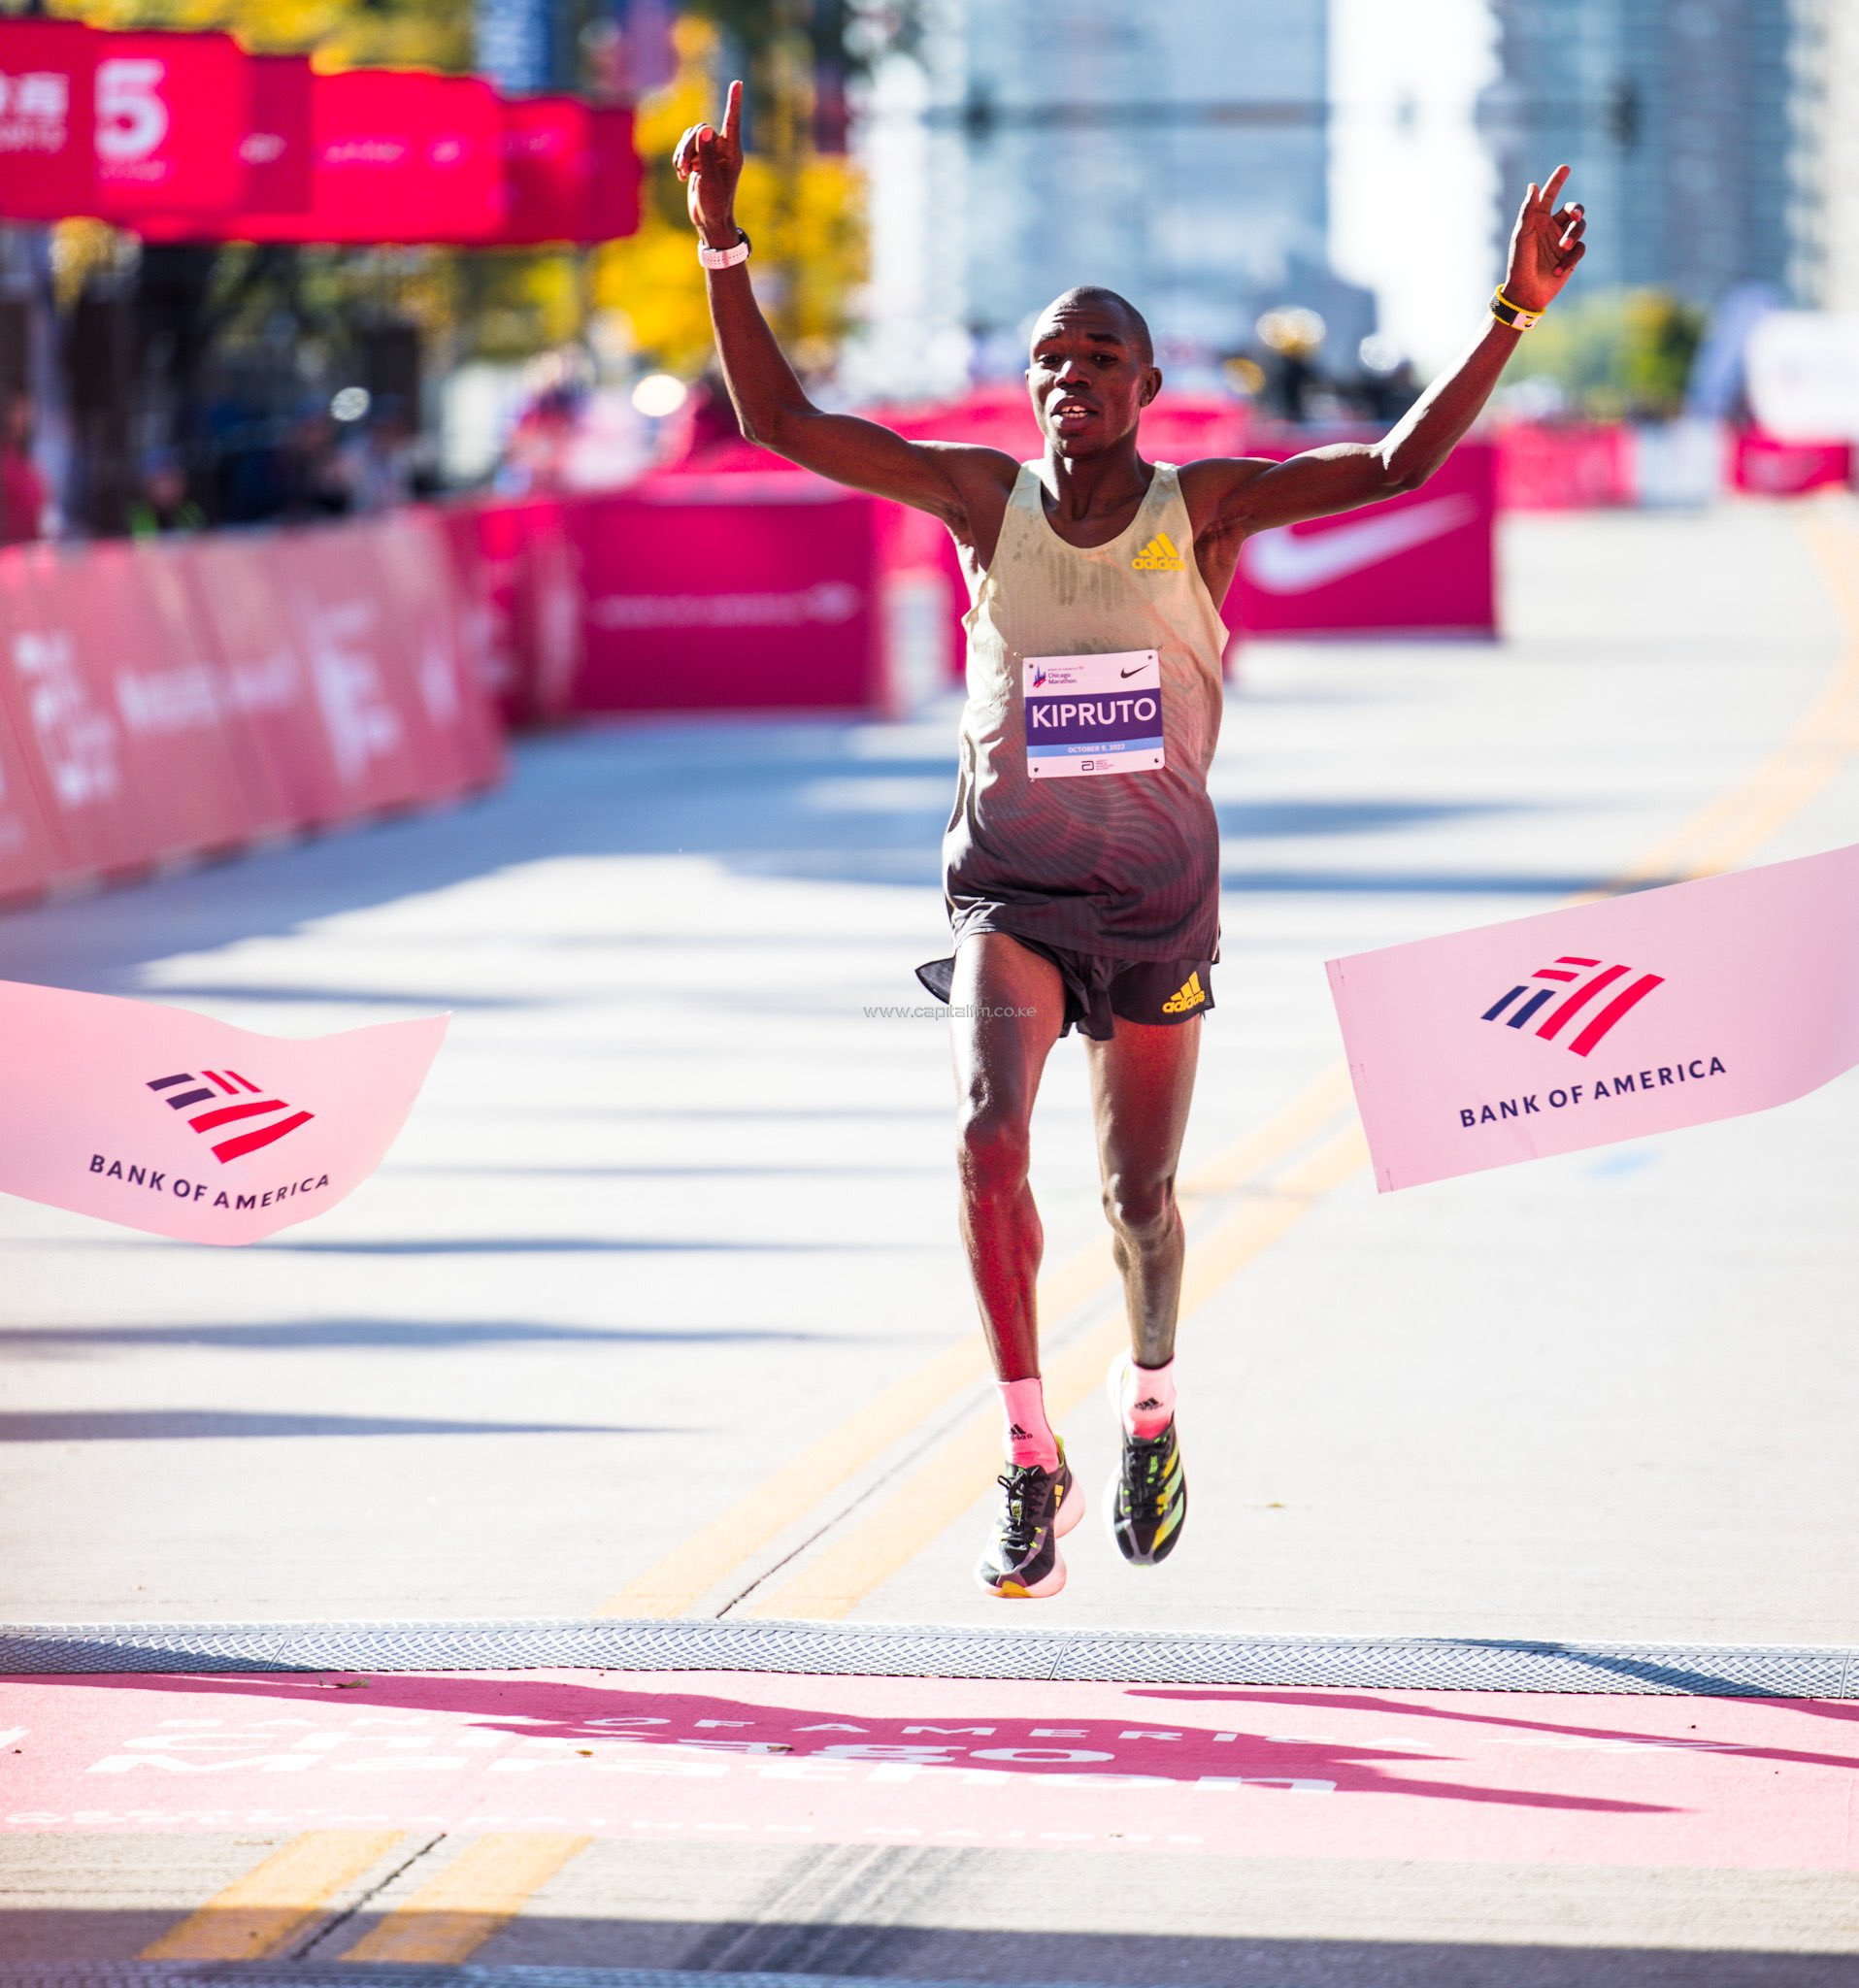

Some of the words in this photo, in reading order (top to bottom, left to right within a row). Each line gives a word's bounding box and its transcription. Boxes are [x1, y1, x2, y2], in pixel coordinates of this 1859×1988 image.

[94, 58, 169, 157] 5
[1132, 554, 1185, 572] adidas
[1032, 697, 1157, 728] KIPRUTO
[1068, 745, 1100, 753] OCTOBER
[1162, 990, 1206, 1013] adidas
[1459, 1094, 1541, 1128] BANK
[1548, 1085, 1583, 1108] OF
[1593, 1056, 1727, 1100] AMERICA
[88, 1153, 166, 1192] BANK
[173, 1178, 208, 1202] OF
[213, 1174, 330, 1210] AMERICA
[582, 1717, 756, 1729] OF
[789, 1722, 1434, 1748] AMERICA
